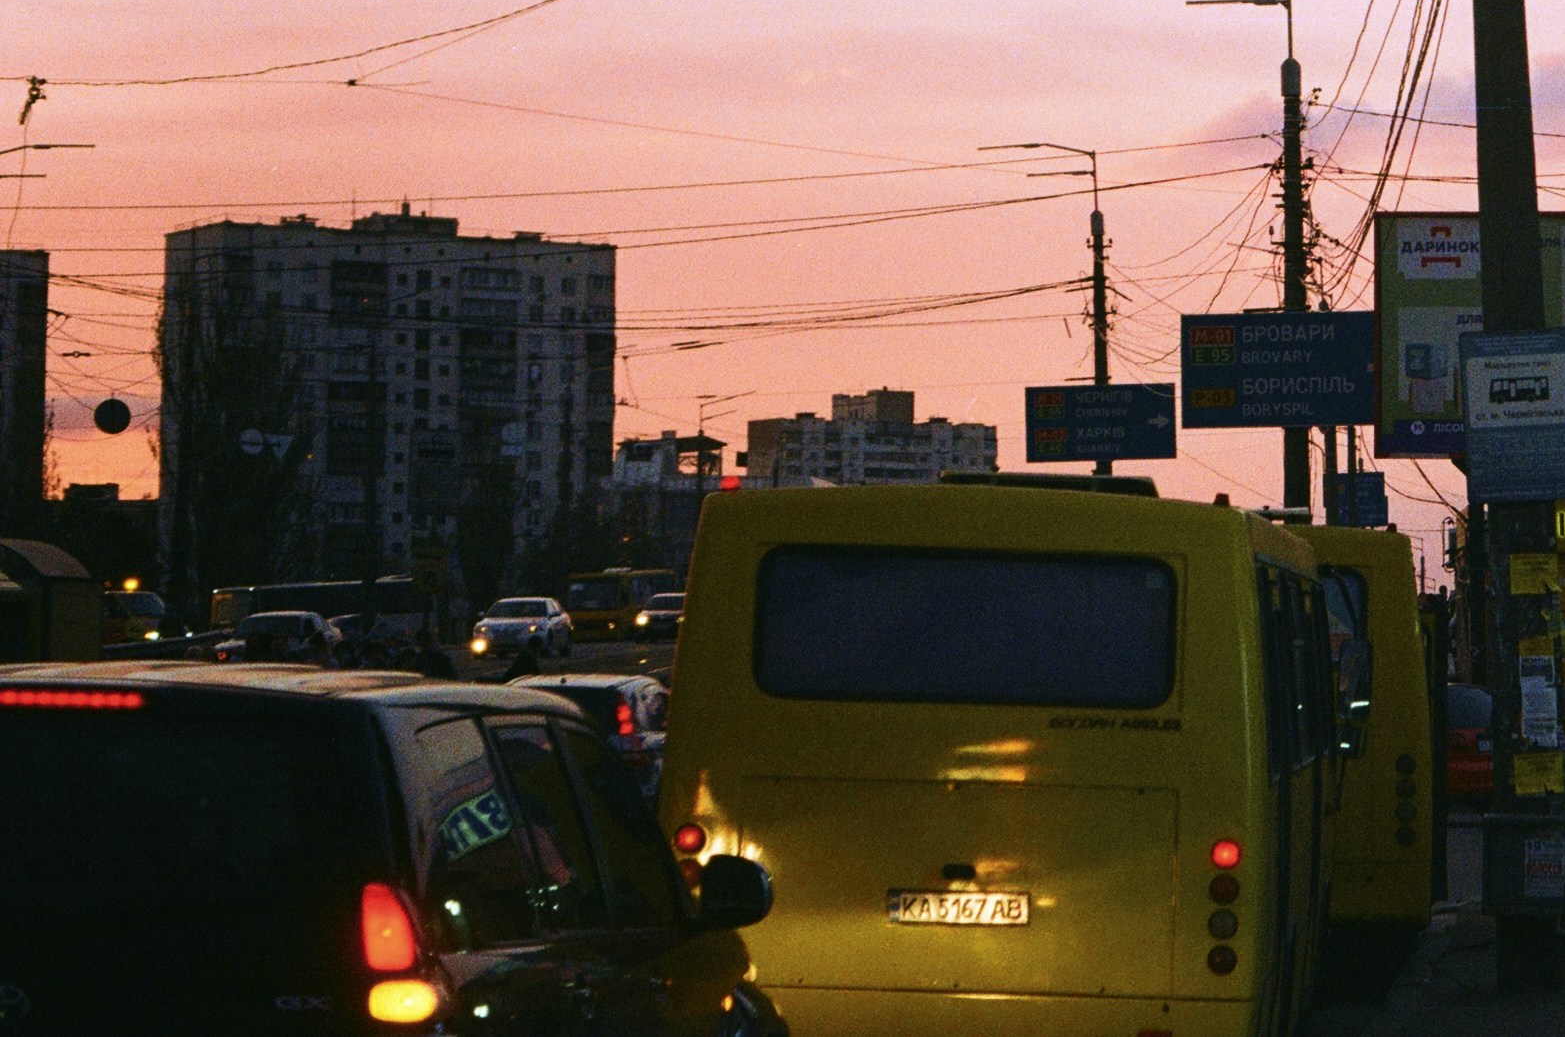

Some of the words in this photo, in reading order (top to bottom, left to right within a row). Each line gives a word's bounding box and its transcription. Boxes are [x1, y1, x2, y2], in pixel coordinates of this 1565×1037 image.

[1241, 324, 1335, 343] БРОВАРИ
[1241, 350, 1313, 364] BROVARY
[1242, 376, 1356, 395] БОРИСПІЛЬ
[1242, 403, 1314, 417] BORYSPIL
[1076, 427, 1126, 440] ХАРКІВ
[938, 898, 988, 921] 5167
